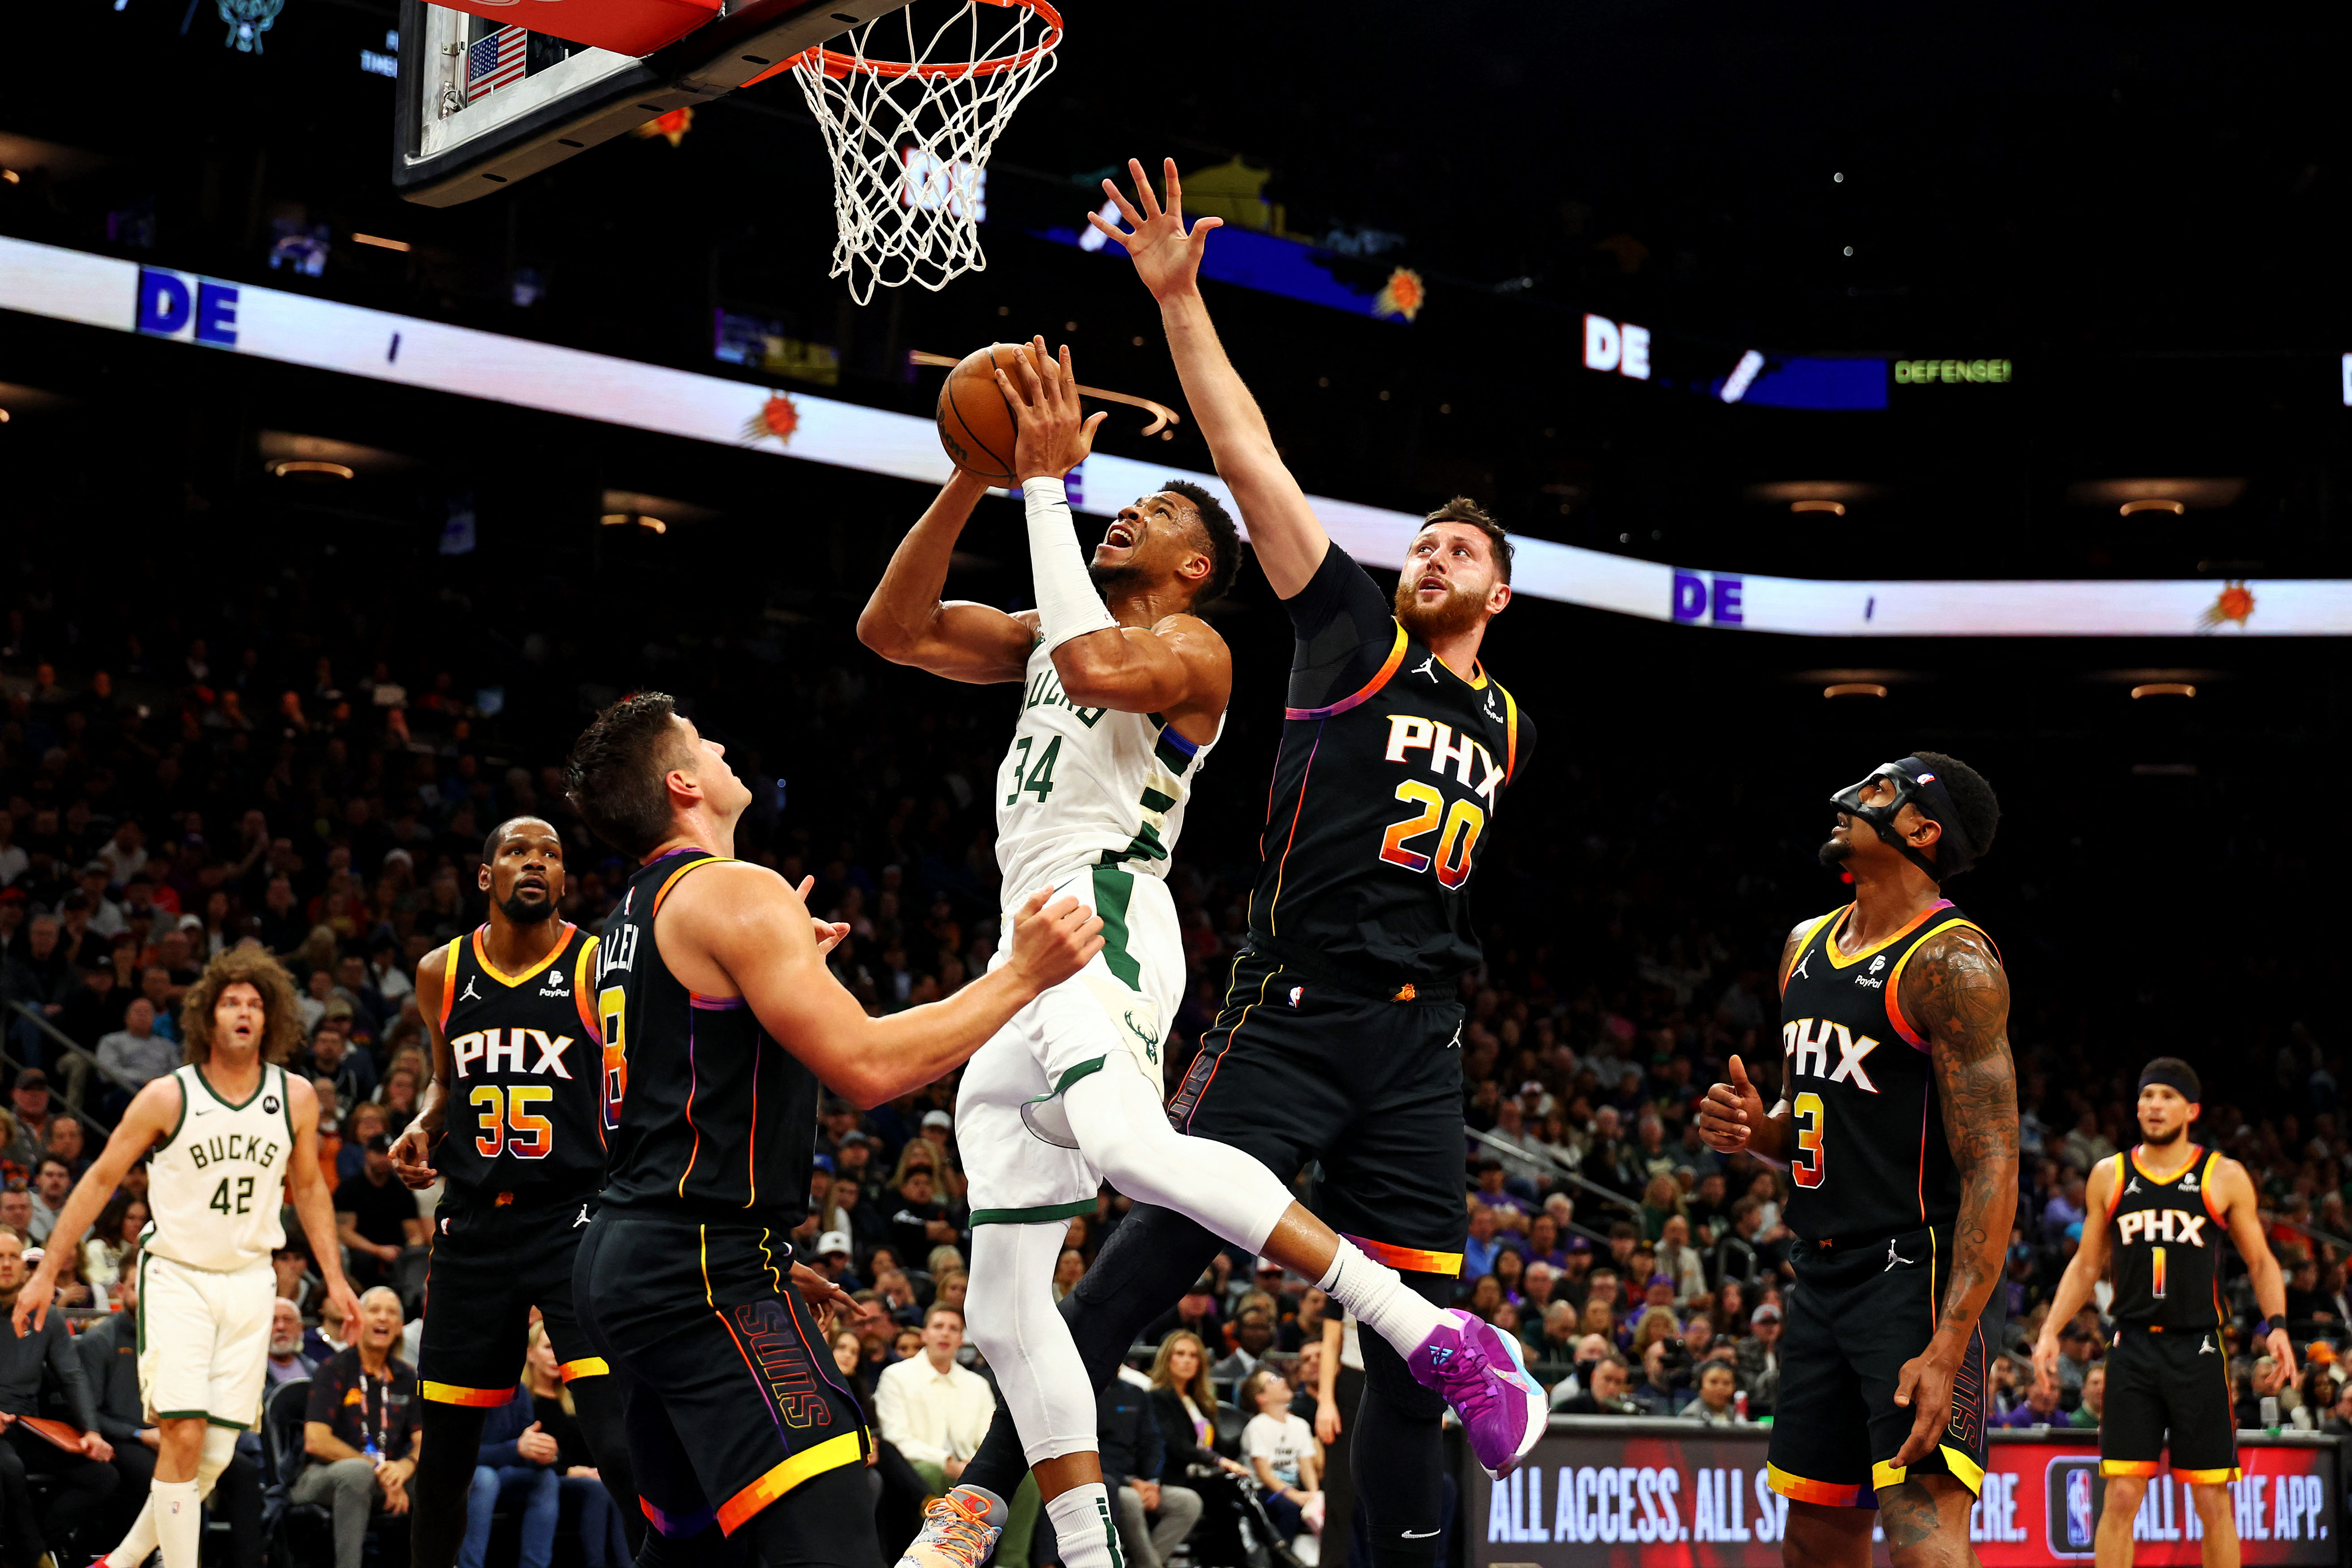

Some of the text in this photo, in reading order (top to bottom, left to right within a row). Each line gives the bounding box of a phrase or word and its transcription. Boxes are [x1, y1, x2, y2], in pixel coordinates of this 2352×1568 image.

[138, 267, 239, 346] DE
[1583, 313, 1651, 380] DE
[1895, 359, 2012, 384] DEFENSE!
[1673, 568, 1743, 625] DE
[1484, 703, 1504, 724] PayPal
[1005, 734, 1064, 807] 34
[1385, 714, 1505, 818] PHX
[1379, 779, 1484, 890] 20
[539, 988, 570, 998] PayPal
[1855, 974, 1883, 989] PayPal
[450, 1027, 575, 1080] PHX
[598, 985, 627, 1130] 8
[189, 1134, 279, 1169] BUCKS
[470, 1085, 552, 1159] 35
[1792, 1091, 1824, 1189] 3
[210, 1176, 255, 1215] 42
[2117, 1209, 2207, 1248] PHX
[2152, 1247, 2167, 1298] 1
[735, 1299, 831, 1429] SUNS
[1488, 1466, 1549, 1543] ALL
[1554, 1466, 1689, 1543] ACCESS.
[1694, 1468, 1751, 1542] ALL
[2133, 1474, 2181, 1541] ALL
[2274, 1475, 2328, 1541] APP.
